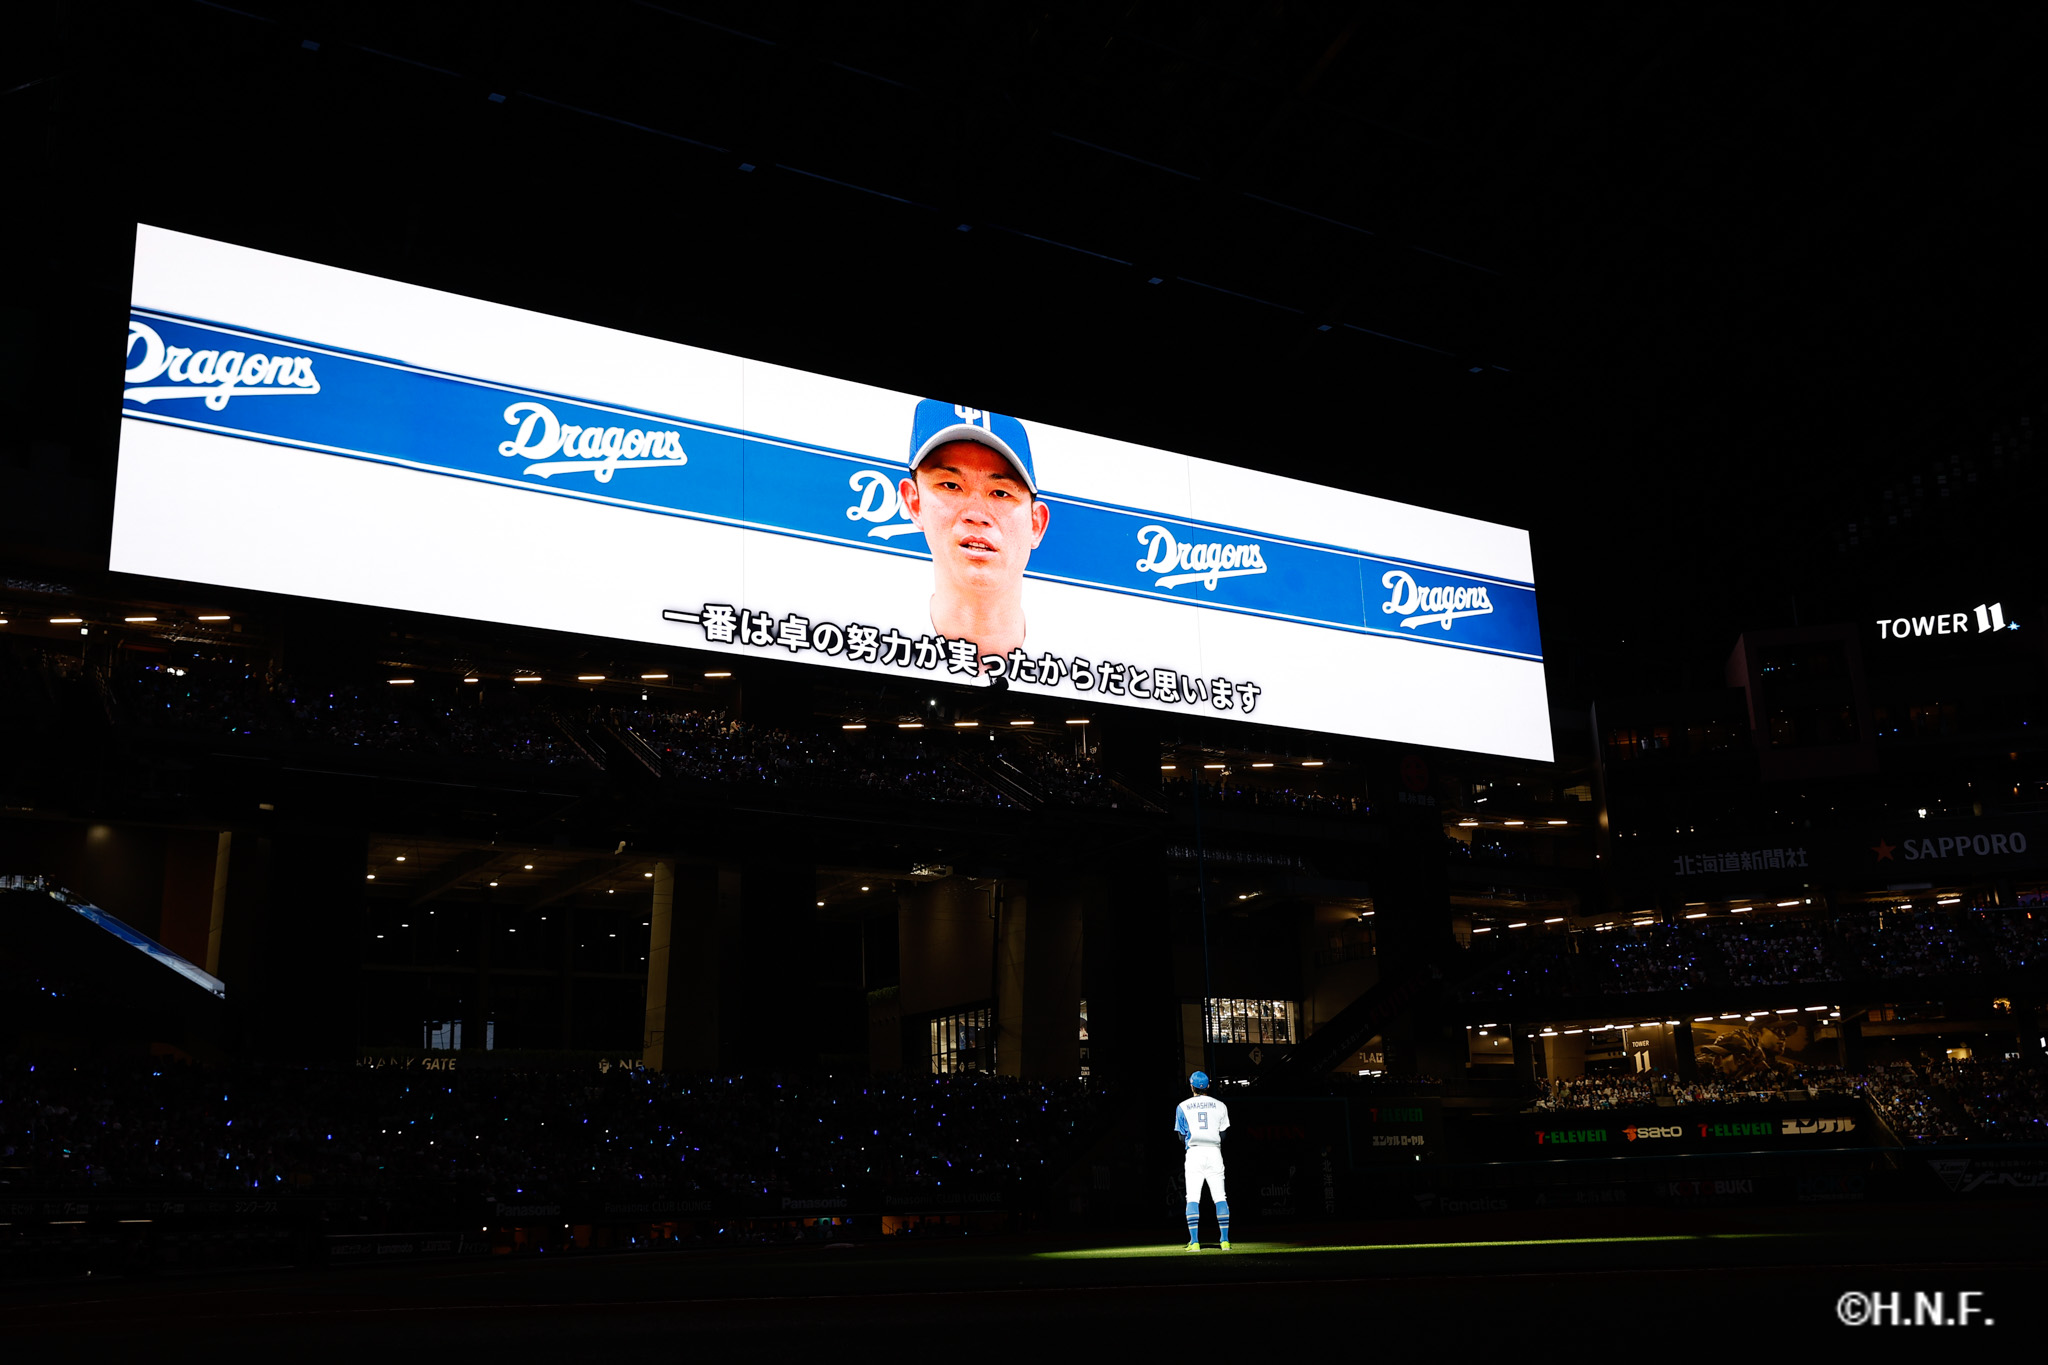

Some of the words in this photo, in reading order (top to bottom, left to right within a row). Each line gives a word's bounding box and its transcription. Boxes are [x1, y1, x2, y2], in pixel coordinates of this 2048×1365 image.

[124, 321, 321, 411] Dragons
[498, 401, 688, 483] Dragons
[1136, 524, 1268, 591] Dragons
[1382, 570, 1494, 630] Dragons
[1876, 612, 1969, 640] TOWER
[1973, 602, 2007, 634] 11
[663, 602, 1262, 713] 一番は卓の努力が実ったからだと思います
[1903, 831, 2028, 861] SAPPORO
[1673, 847, 1809, 876] 北海道新聞社
[1632, 1040, 1650, 1048] TOWER
[1633, 1050, 1653, 1074] 11
[1186, 1102, 1217, 1110] NAKASHIMA
[1198, 1112, 1209, 1130] 9
[1781, 1117, 1856, 1135] ユンケル
[963, 1192, 1002, 1203] LOUNGE
[1668, 1180, 1753, 1197] KOTOBUKI
[495, 1203, 561, 1217] Panasonic
[676, 1200, 713, 1212] LOUNGE
[781, 1197, 849, 1210] Panasonic
[1439, 1194, 1509, 1213] Fanatics
